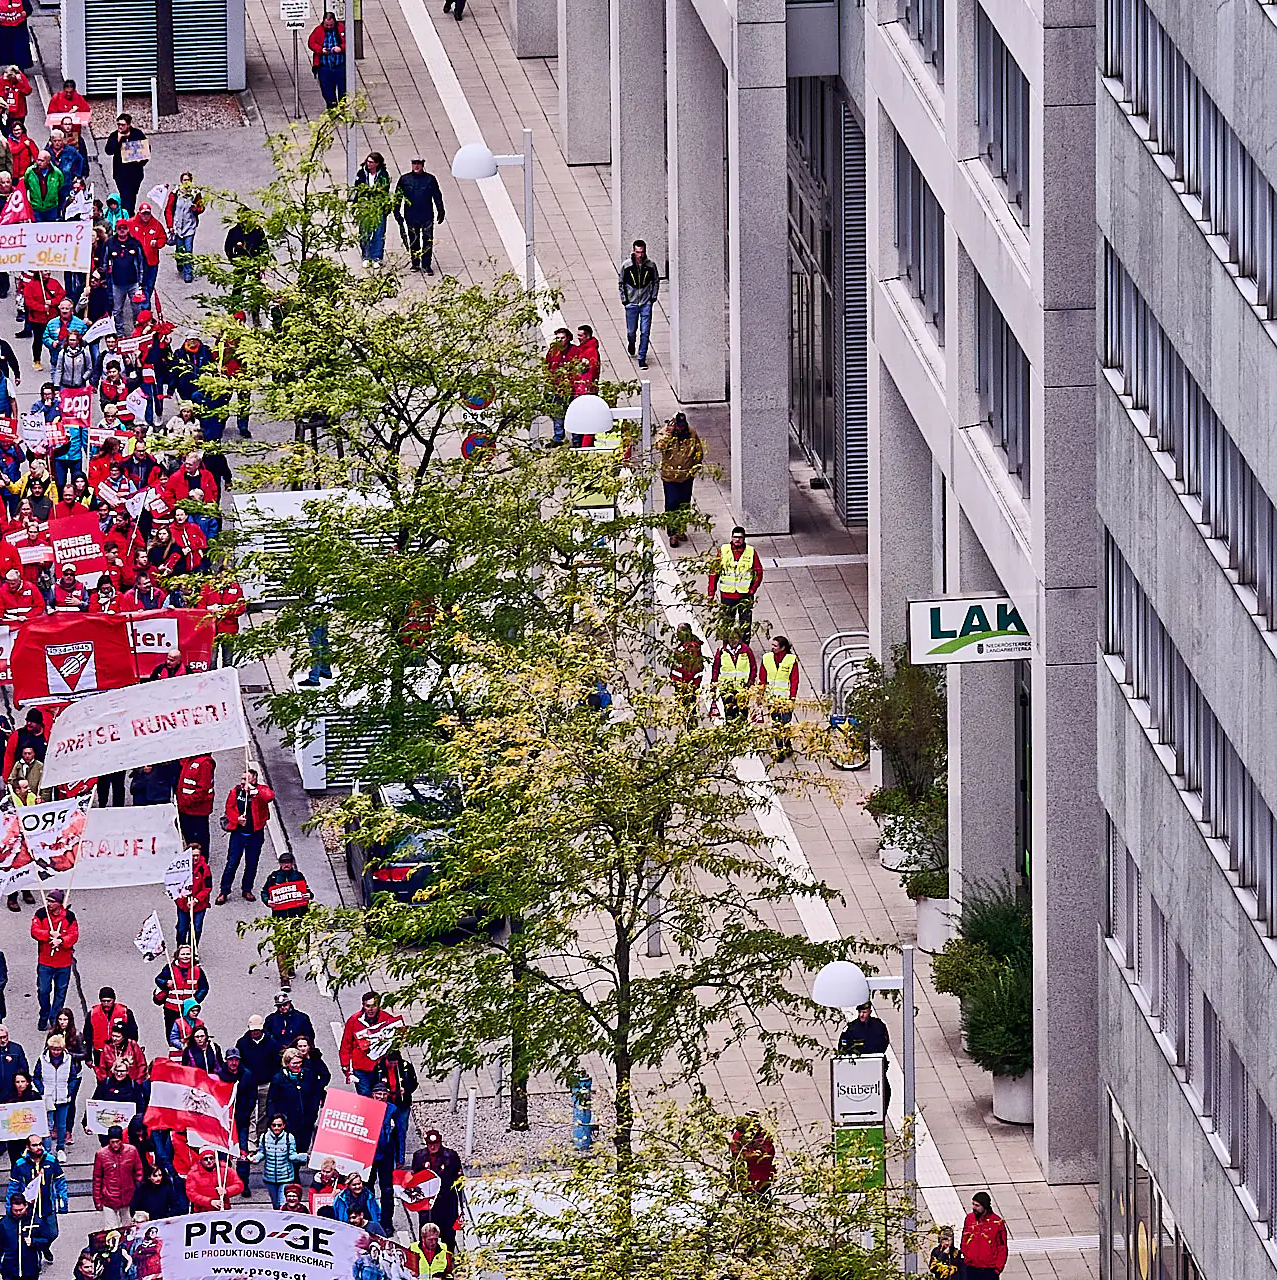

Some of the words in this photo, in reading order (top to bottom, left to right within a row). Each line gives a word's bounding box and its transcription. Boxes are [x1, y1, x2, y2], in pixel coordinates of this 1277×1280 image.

[54, 534, 92, 550] PREISE
[56, 543, 100, 563] RUNTER
[930, 604, 1029, 639] LAK
[189, 661, 208, 671] SPÖ
[55, 725, 120, 758] PREISE
[133, 704, 229, 737] RUNTER!
[271, 885, 297, 898] PREISE
[273, 891, 303, 904] RUNTER
[839, 1084, 878, 1095] Stüberl
[324, 1108, 364, 1126] PREISE
[322, 1118, 369, 1137] RUNTER
[184, 1219, 335, 1257] PRO-GE
[185, 1251, 199, 1259] DIE
[201, 1249, 334, 1270] PRODUKTIONSGEWERKSCHAFT
